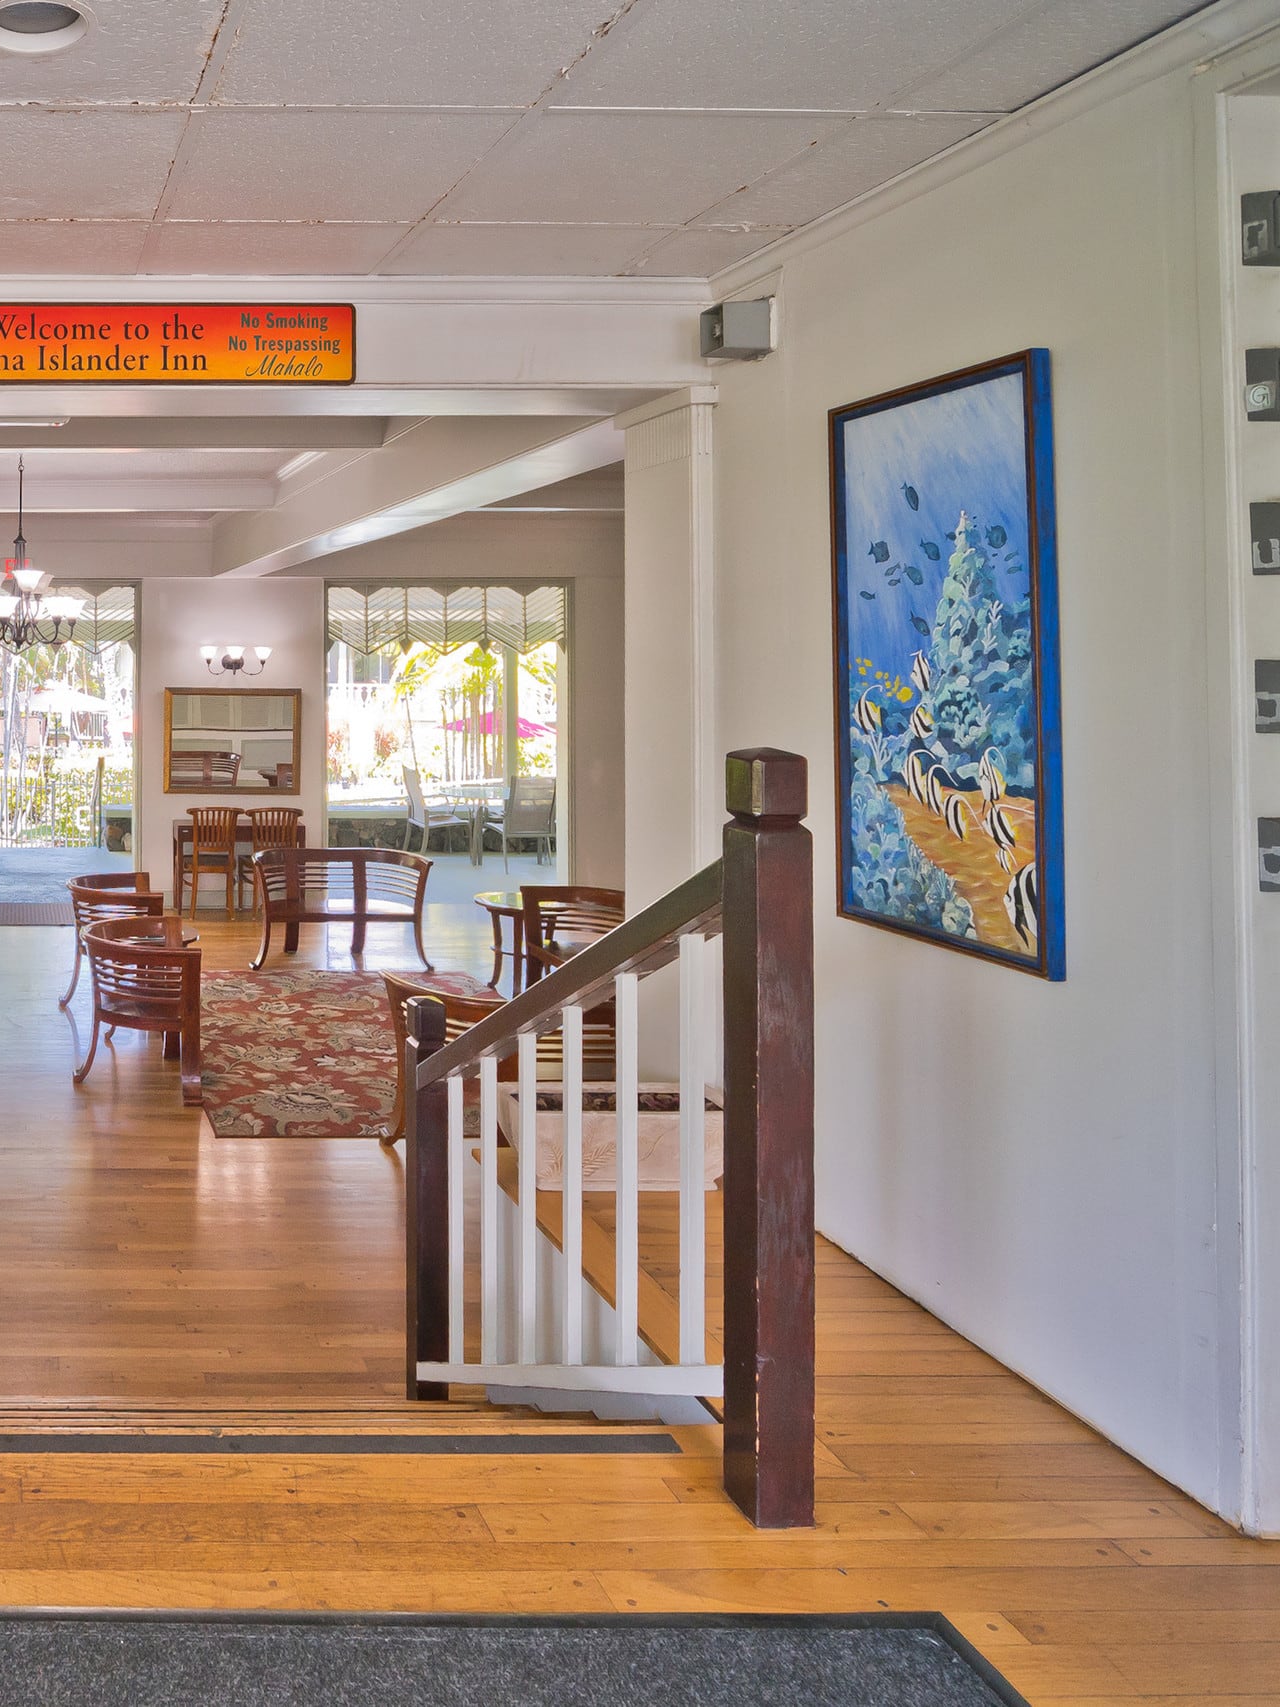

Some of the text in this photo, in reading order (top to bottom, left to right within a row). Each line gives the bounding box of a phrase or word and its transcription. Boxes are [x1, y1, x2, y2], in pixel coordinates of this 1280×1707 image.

[123, 321, 150, 340] to
[162, 313, 205, 340] the
[240, 312, 329, 332] No Smoking
[228, 335, 341, 354] No Trespassing
[37, 344, 150, 371] Islander
[160, 345, 209, 371] Inn
[245, 354, 323, 377] Mahalo
